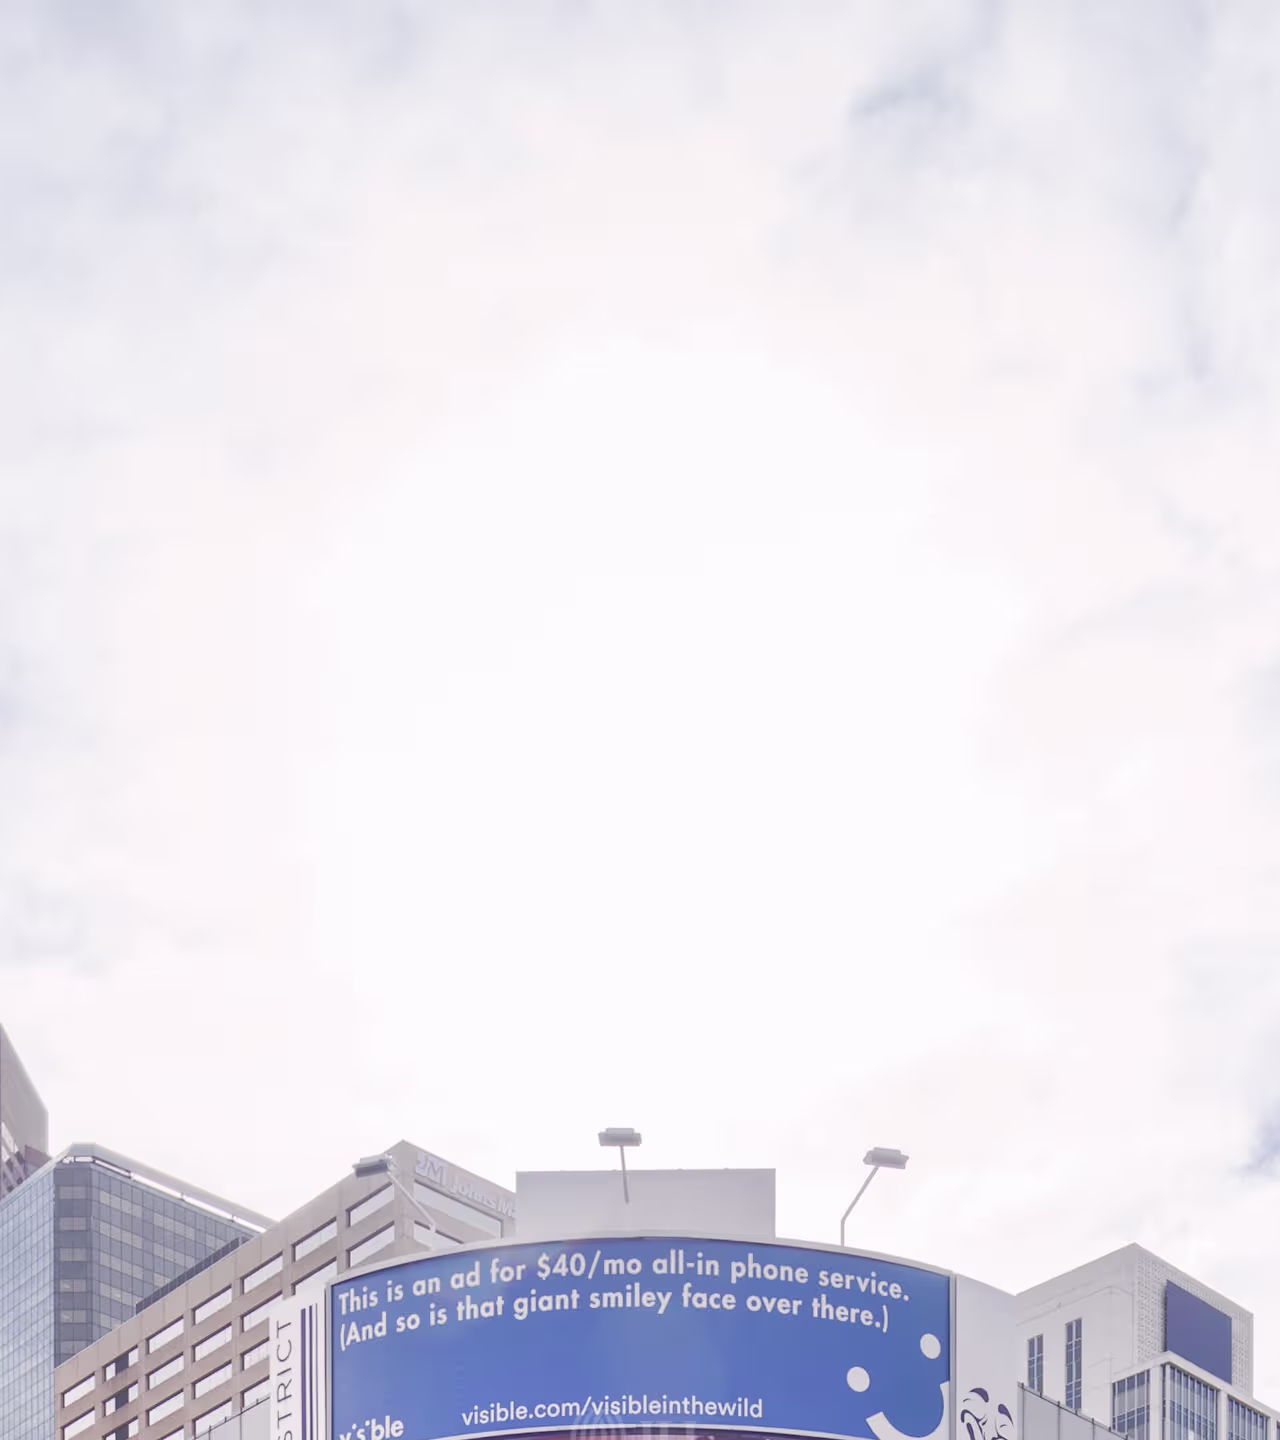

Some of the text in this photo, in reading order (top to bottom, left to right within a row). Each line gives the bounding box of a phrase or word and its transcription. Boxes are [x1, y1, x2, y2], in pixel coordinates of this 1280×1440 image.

[339, 1249, 910, 1315] This is an ad for $40/mo all-in phone service.
[339, 1283, 889, 1351] (And so is that giant smiley face over there.)
[462, 1395, 763, 1426] visible.com/visibleinthewild
